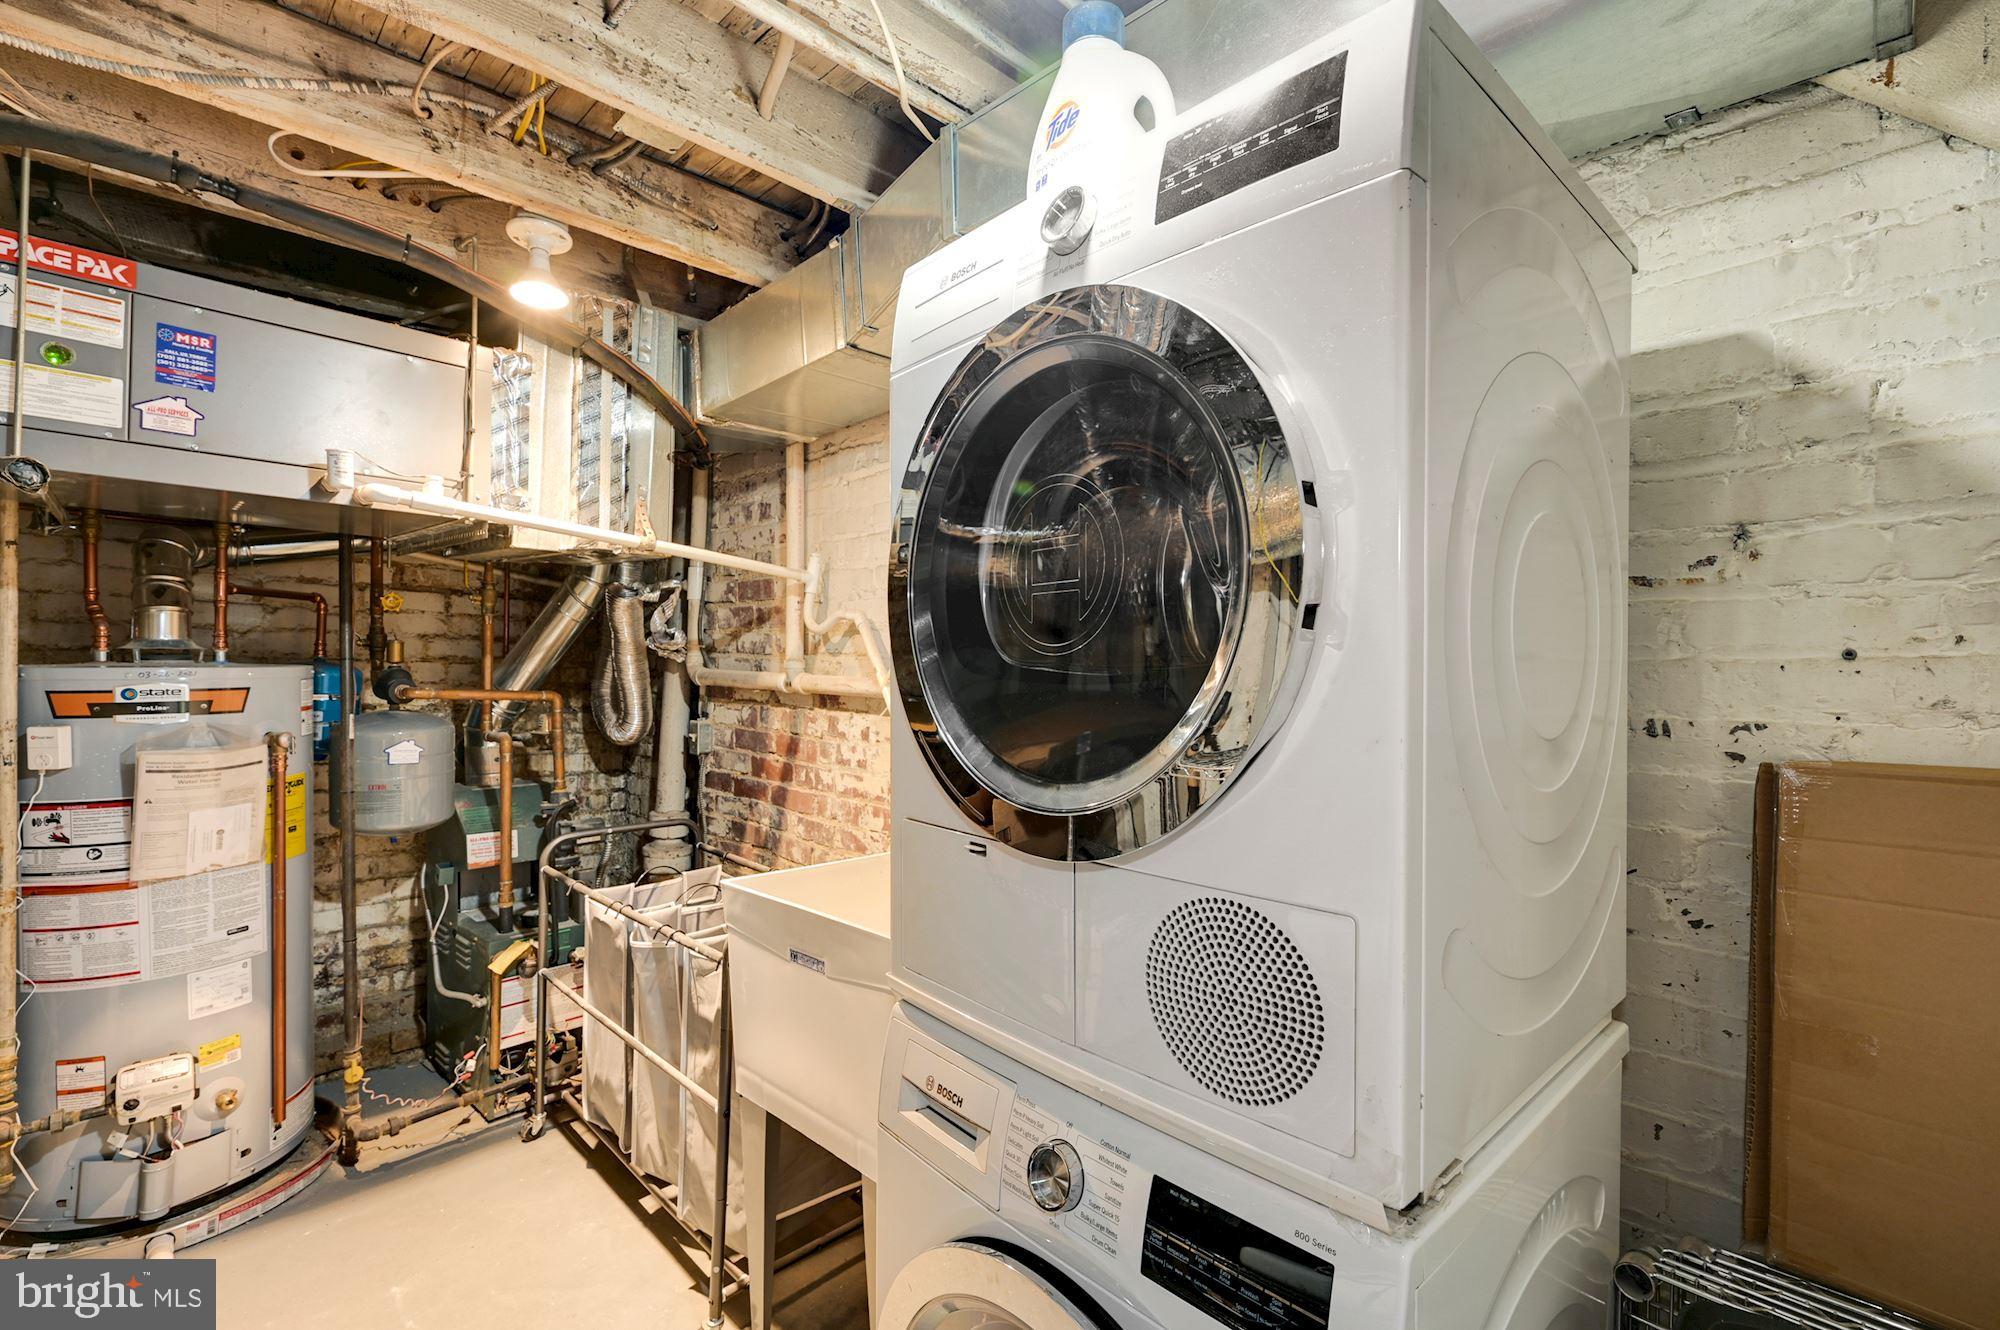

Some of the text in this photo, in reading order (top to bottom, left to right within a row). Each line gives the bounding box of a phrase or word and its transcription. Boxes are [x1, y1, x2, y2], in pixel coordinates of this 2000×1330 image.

[1046, 107, 1080, 152] Tide
[1283, 124, 1298, 135] Signal
[77, 254, 129, 284] PAK
[951, 260, 977, 282] BOSCH
[176, 332, 212, 349] MSR
[139, 688, 182, 697] state
[937, 1083, 964, 1109] BOSCH
[1099, 1138, 1131, 1160] Cotton Normal
[1098, 1154, 1128, 1174] Whitest White
[1110, 1177, 1125, 1191] Towels
[1088, 1199, 1101, 1211] Super
[1101, 1206, 1114, 1219] Quick
[1104, 1192, 1122, 1207] Sanitize
[1106, 1227, 1118, 1240] Items
[1294, 1229, 1337, 1257] 800 Series
[1091, 1234, 1117, 1256] Drum Clean
